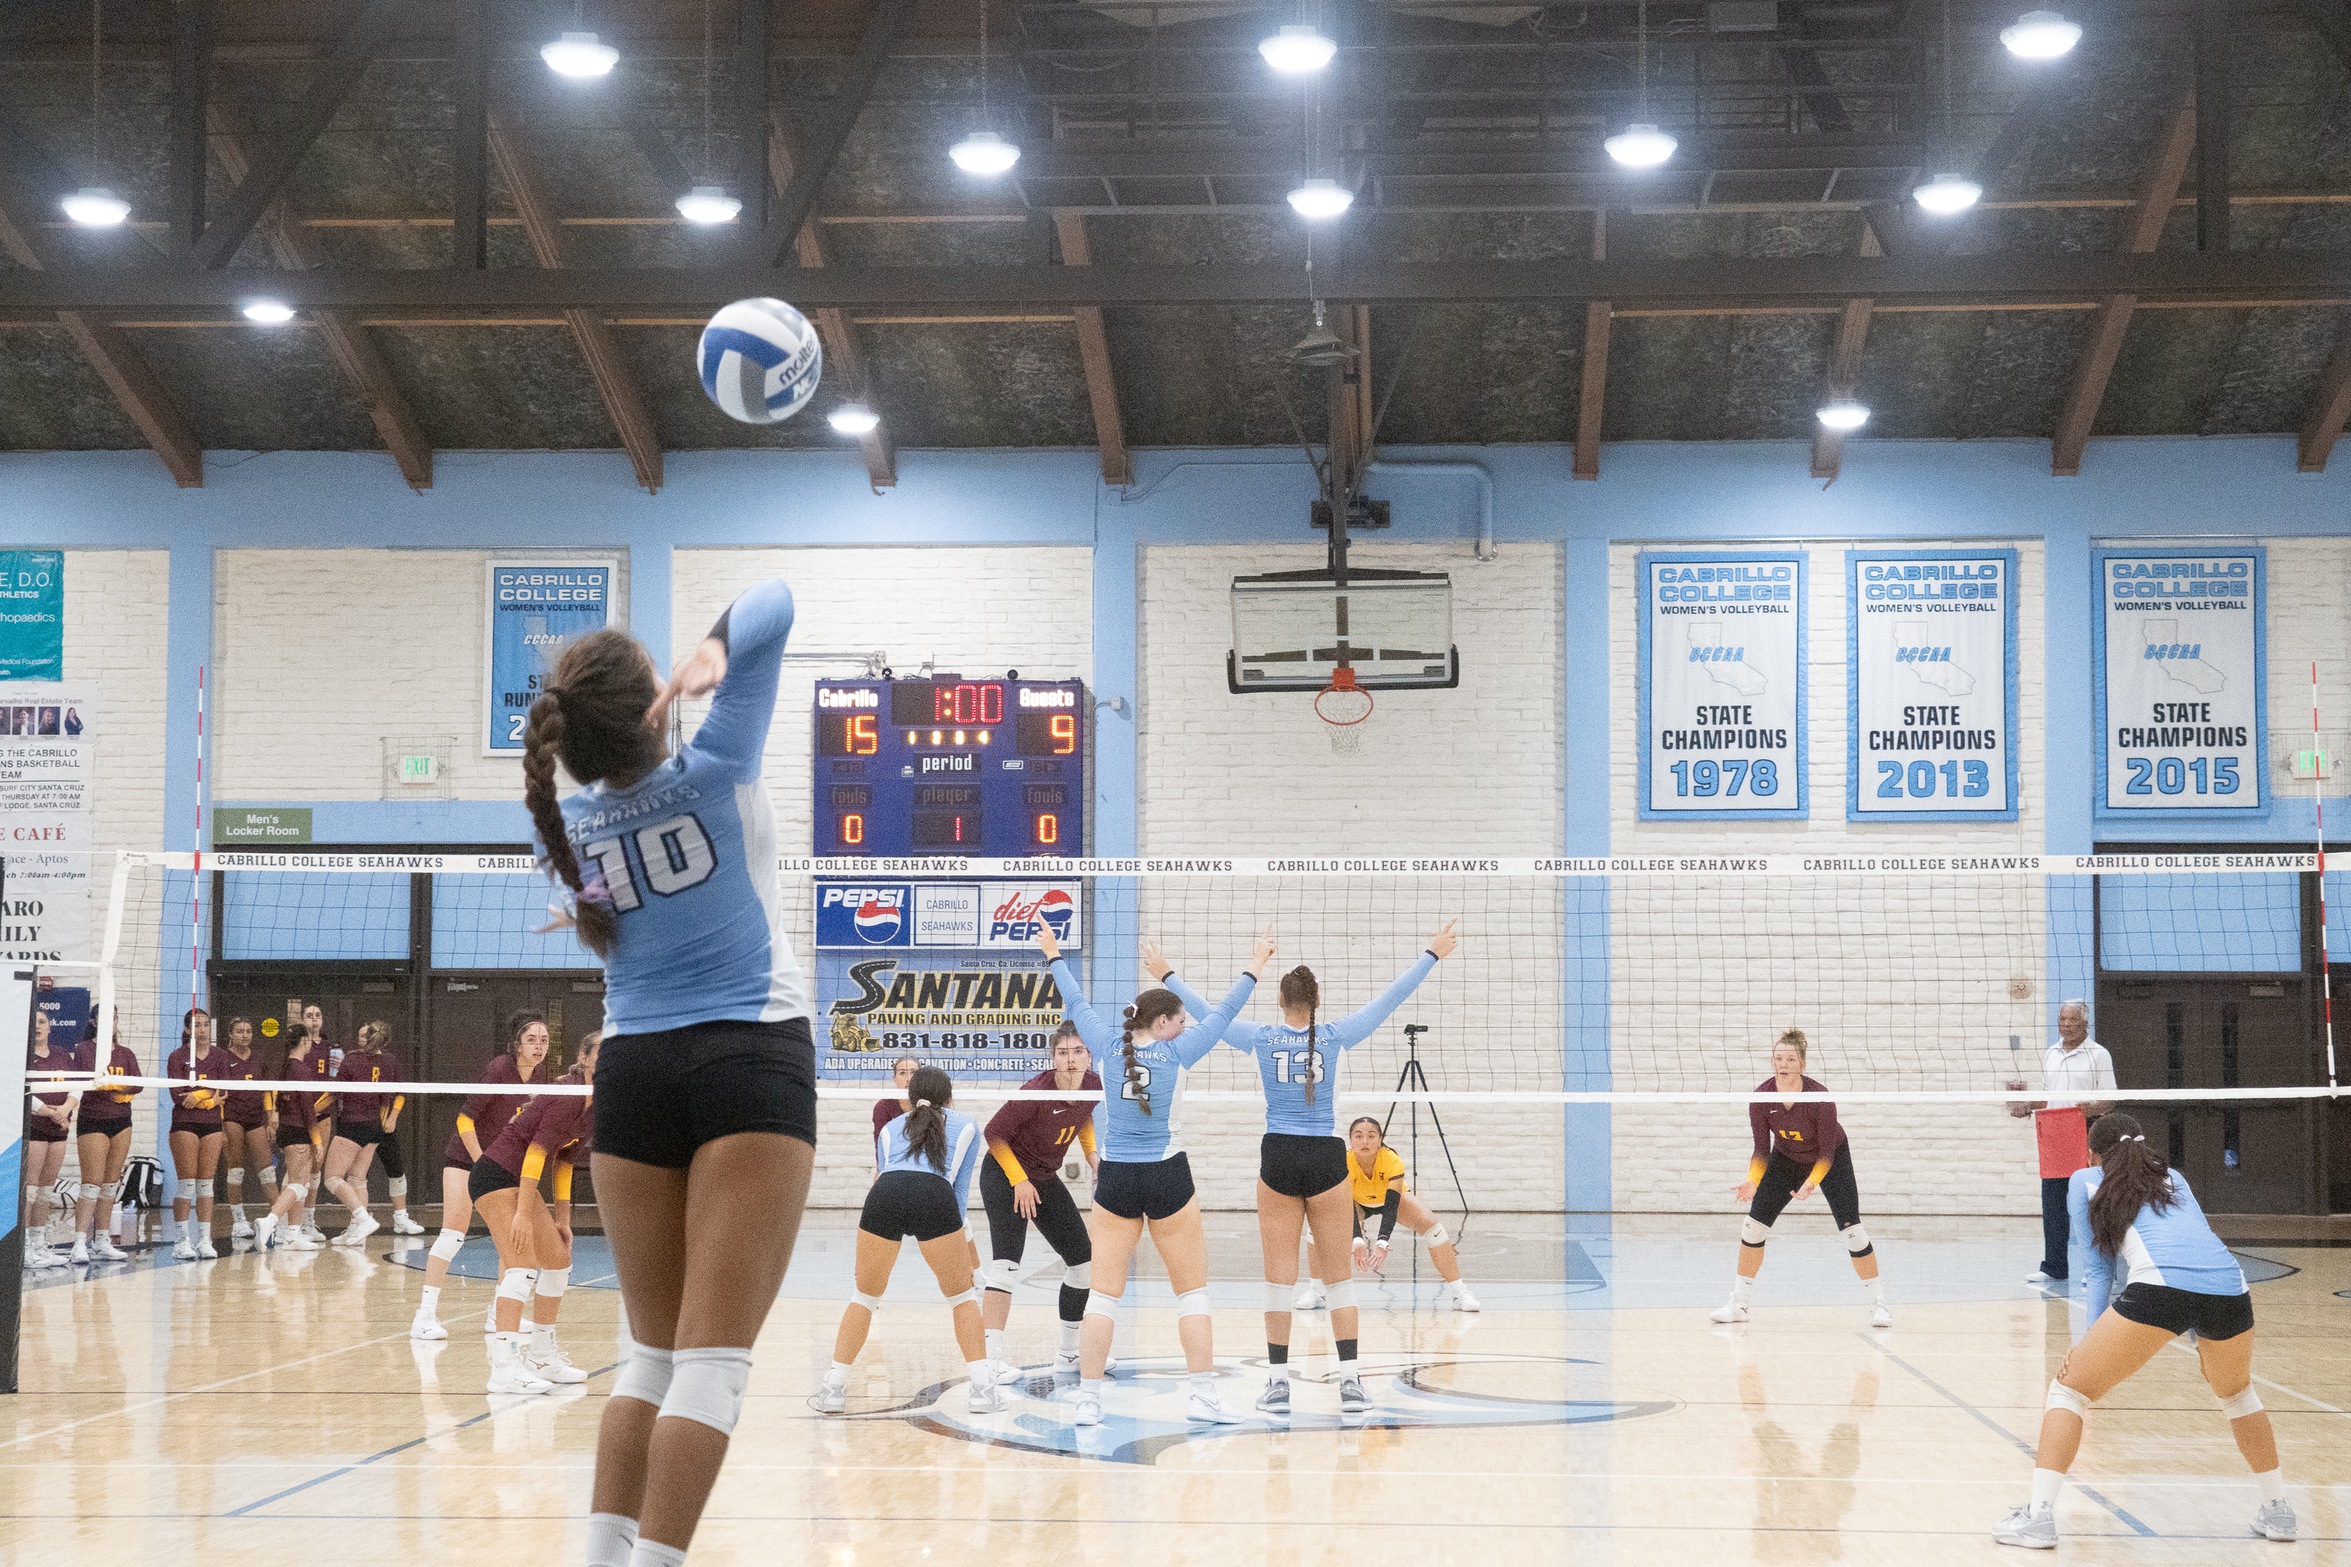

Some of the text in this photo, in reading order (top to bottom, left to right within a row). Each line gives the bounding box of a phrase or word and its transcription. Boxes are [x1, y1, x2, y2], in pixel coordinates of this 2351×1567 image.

[19, 572, 53, 587] D.O.
[1659, 567, 1792, 583] CABRILLO
[1865, 565, 1998, 581] CABRILLO
[2112, 563, 2248, 579] CABRILLO
[500, 575, 603, 586] CABRILLO
[500, 588, 602, 600] COLLEGE
[1659, 585, 1791, 602] COLLEGE
[1865, 583, 1998, 600] COLLEGE
[2113, 581, 2248, 598] COLLEGE
[1660, 604, 1789, 615] WOMEN'S VOLLEYBALL
[1866, 603, 1997, 612] WOMEN'S VOLLEYBALL
[2114, 601, 2247, 611] WOMEN'S VOLLEYBALL
[818, 688, 878, 708] Cabrillo
[935, 684, 1003, 723] 1:00
[1696, 705, 1752, 725] STATE
[1903, 705, 1960, 726] STATE
[2153, 703, 2211, 723] STATE
[845, 715, 878, 754] 15
[931, 730, 943, 745] 2
[954, 730, 965, 745] 3
[977, 730, 989, 745] 4
[1051, 715, 1074, 754] 9
[1662, 729, 1787, 750] CHAMPIONS
[1869, 729, 1996, 750] CHAMPIONS
[2118, 727, 2247, 748] CHAMPIONS
[7, 749, 25, 757] THE
[28, 749, 77, 757] CABRILLO
[17, 760, 80, 768] BASKETBALL
[405, 757, 431, 775] EXIT
[922, 754, 973, 773] period
[1670, 759, 1778, 796] 1978
[1877, 759, 1989, 798] 2013
[2126, 757, 2240, 794] 2015
[922, 786, 973, 807] player
[246, 814, 279, 825] Men's
[14, 822, 66, 841] CAFÉ
[226, 826, 299, 836] Locker Room
[844, 815, 863, 843] 0
[1039, 815, 1057, 843] 0
[36, 854, 69, 866] Aptos
[217, 855, 443, 868] CABRILLO COLLEGE SEAHAWKS
[582, 812, 718, 914] 10
[815, 860, 878, 871] COLLEGE
[883, 860, 968, 871] SEAHAWKS
[1003, 861, 1233, 871] CABRILLO COLLEGE SEAHAWKS
[1267, 860, 1499, 871] CABRILLO COLLEGE SEAHAWKS
[1534, 860, 1768, 871] CABRILLO COLLEGE SEAHAWKS
[1803, 858, 2039, 870] CABRILLO COLLEGE SEAHAWKS
[2075, 855, 2315, 868] CABRILLO COLLEGE SEAHAWKS
[822, 888, 905, 908] PEPSI
[926, 899, 969, 910] CABRILLO
[993, 891, 1050, 923] diet
[921, 921, 973, 931] SEAHAWKS
[960, 960, 980, 968] Santa
[1010, 960, 1035, 968] License
[830, 960, 1063, 1014] SANTANA
[867, 1013, 1061, 1025] PAVING AND GRADING INC
[883, 1032, 1052, 1049] 831-818-180
[1111, 1046, 1167, 1063] SEAWKS
[825, 1058, 845, 1070] ADA
[918, 1058, 967, 1071] CAVATION
[973, 1058, 1024, 1071] CONCRETE
[1271, 1049, 1325, 1084] 13
[1121, 1064, 1152, 1101] 2
[1054, 1125, 1076, 1145] 11
